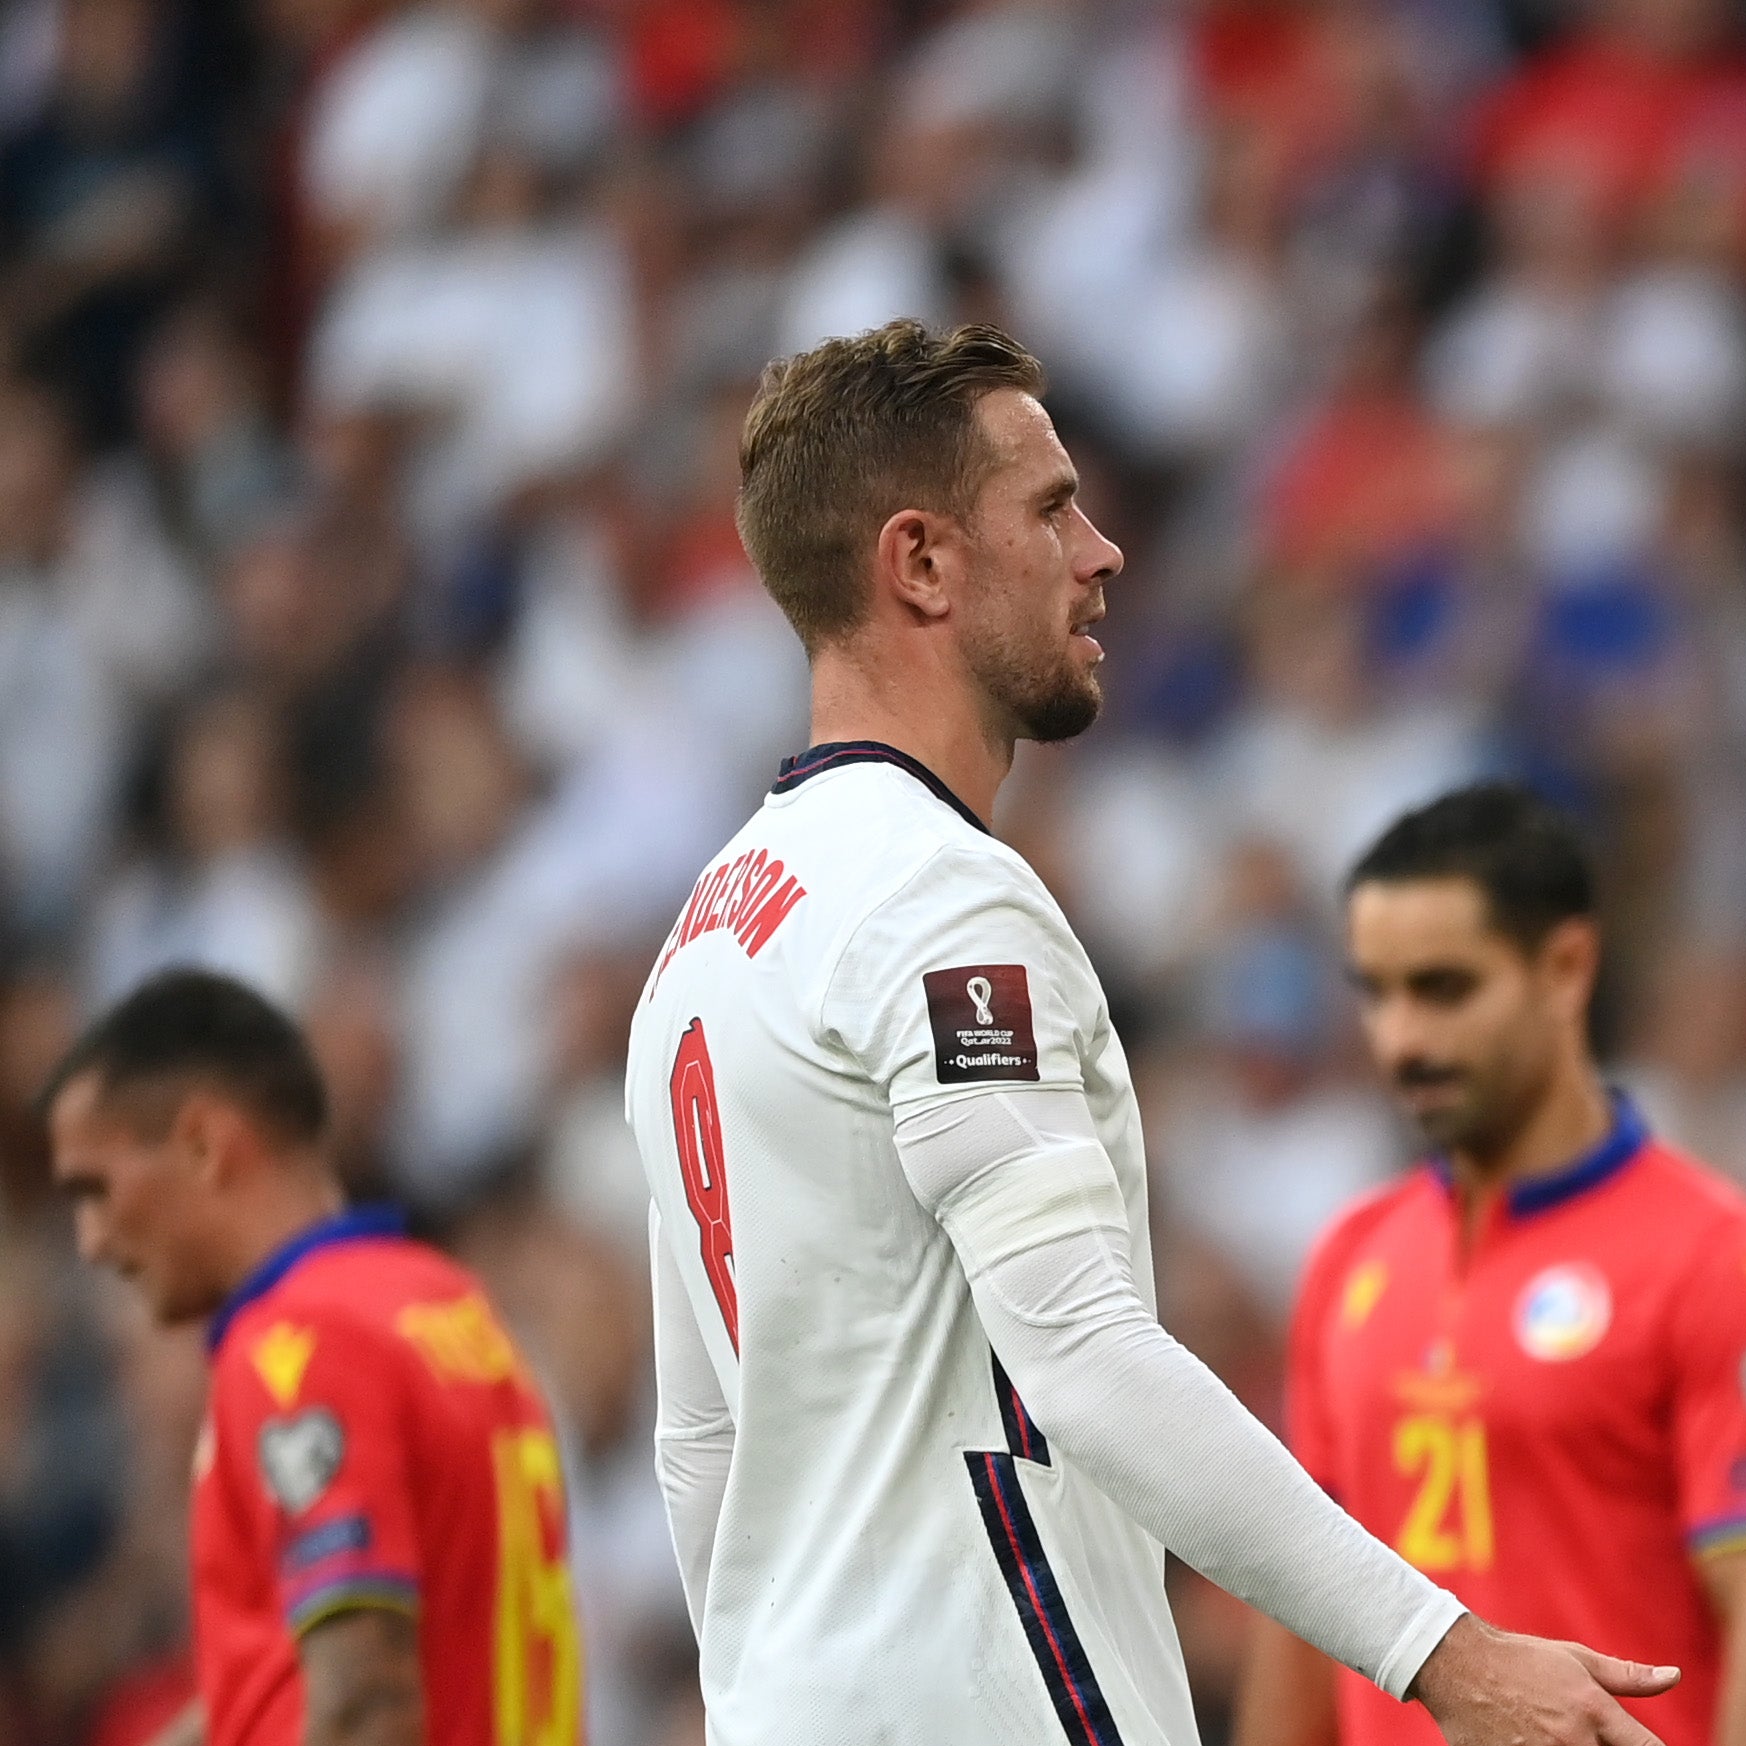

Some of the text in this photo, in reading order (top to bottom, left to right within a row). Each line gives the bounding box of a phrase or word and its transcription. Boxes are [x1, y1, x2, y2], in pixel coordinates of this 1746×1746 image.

[956, 1030, 974, 1038] FIFA
[974, 1029, 1000, 1037] WORLD
[956, 1053, 1022, 1069] Qualifiers
[1393, 1412, 1493, 1574] 21
